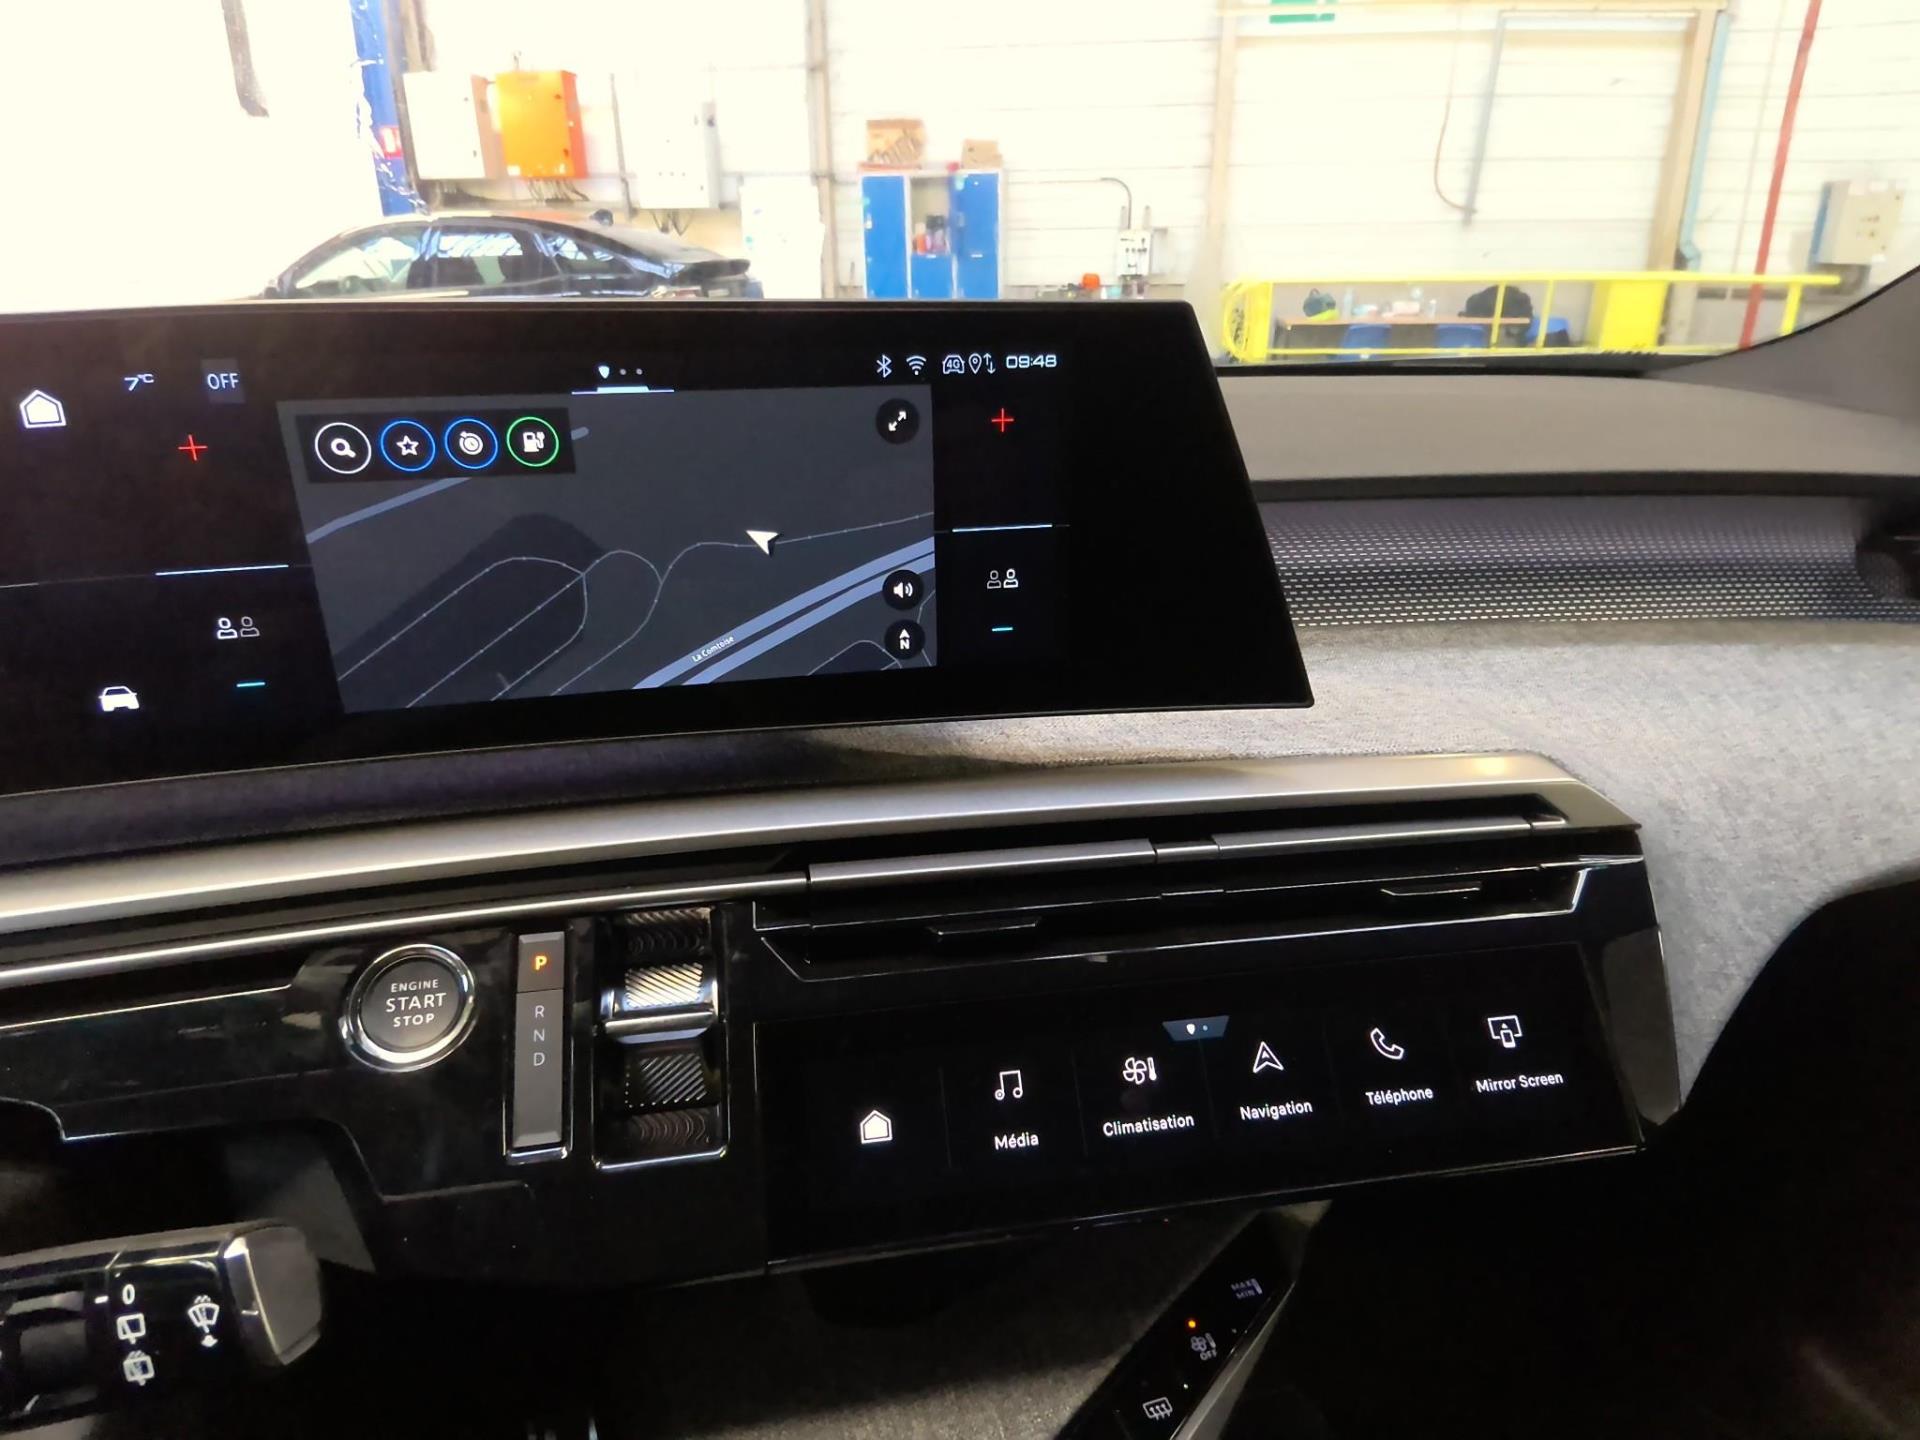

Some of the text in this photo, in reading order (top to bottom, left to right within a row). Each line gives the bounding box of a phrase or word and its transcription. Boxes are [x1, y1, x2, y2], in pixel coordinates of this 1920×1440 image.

[1006, 355, 1057, 369] 09:48
[206, 373, 240, 390] OFF
[691, 636, 734, 663] La Comtoise
[534, 955, 548, 971] P
[390, 978, 440, 993] ENGINE
[386, 992, 447, 1013] START
[534, 1004, 545, 1019] R
[393, 1013, 436, 1028] STOP
[533, 1028, 545, 1042] N
[533, 1052, 546, 1067] D
[1475, 1071, 1564, 1094] Mirror Screen
[1365, 1086, 1434, 1106] Téléphone
[1239, 1100, 1313, 1121] Navigation
[1102, 1114, 1195, 1138] Climatisation
[994, 1131, 1040, 1150] Média
[1199, 1349, 1218, 1361] OFF
